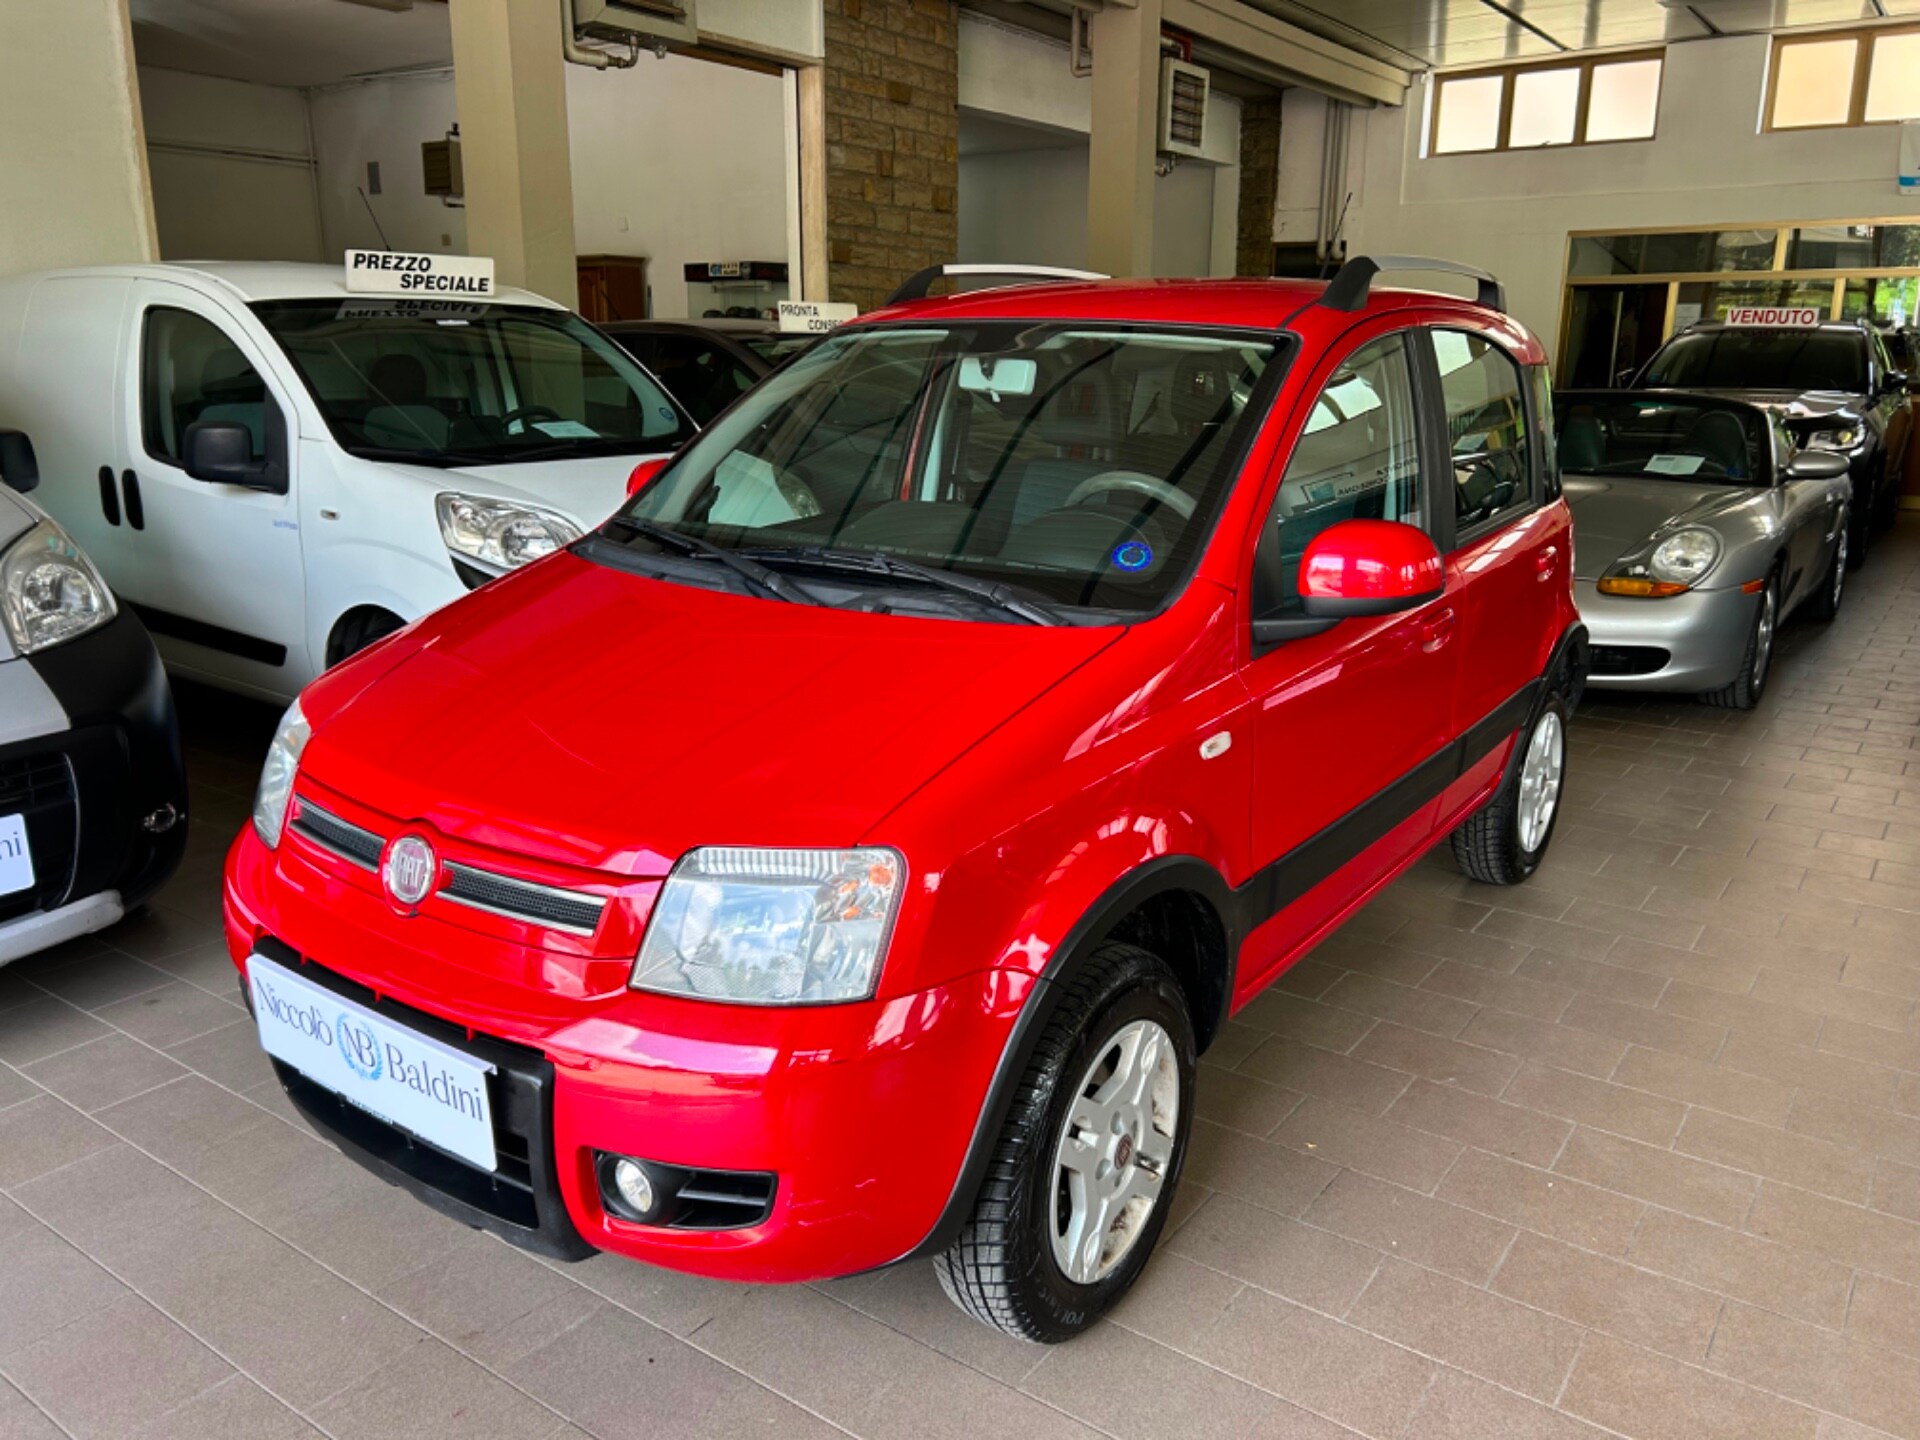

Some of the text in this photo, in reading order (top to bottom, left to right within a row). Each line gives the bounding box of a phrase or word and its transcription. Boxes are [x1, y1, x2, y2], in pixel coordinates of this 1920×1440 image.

[354, 253, 432, 272] PREZZO
[400, 274, 489, 292] SPECIALE
[781, 304, 820, 317] PRONTA
[1730, 310, 1815, 324] VENDUTO
[808, 319, 843, 330] CONSE
[254, 977, 333, 1046] Niccolò
[385, 1042, 483, 1122] Baldini
